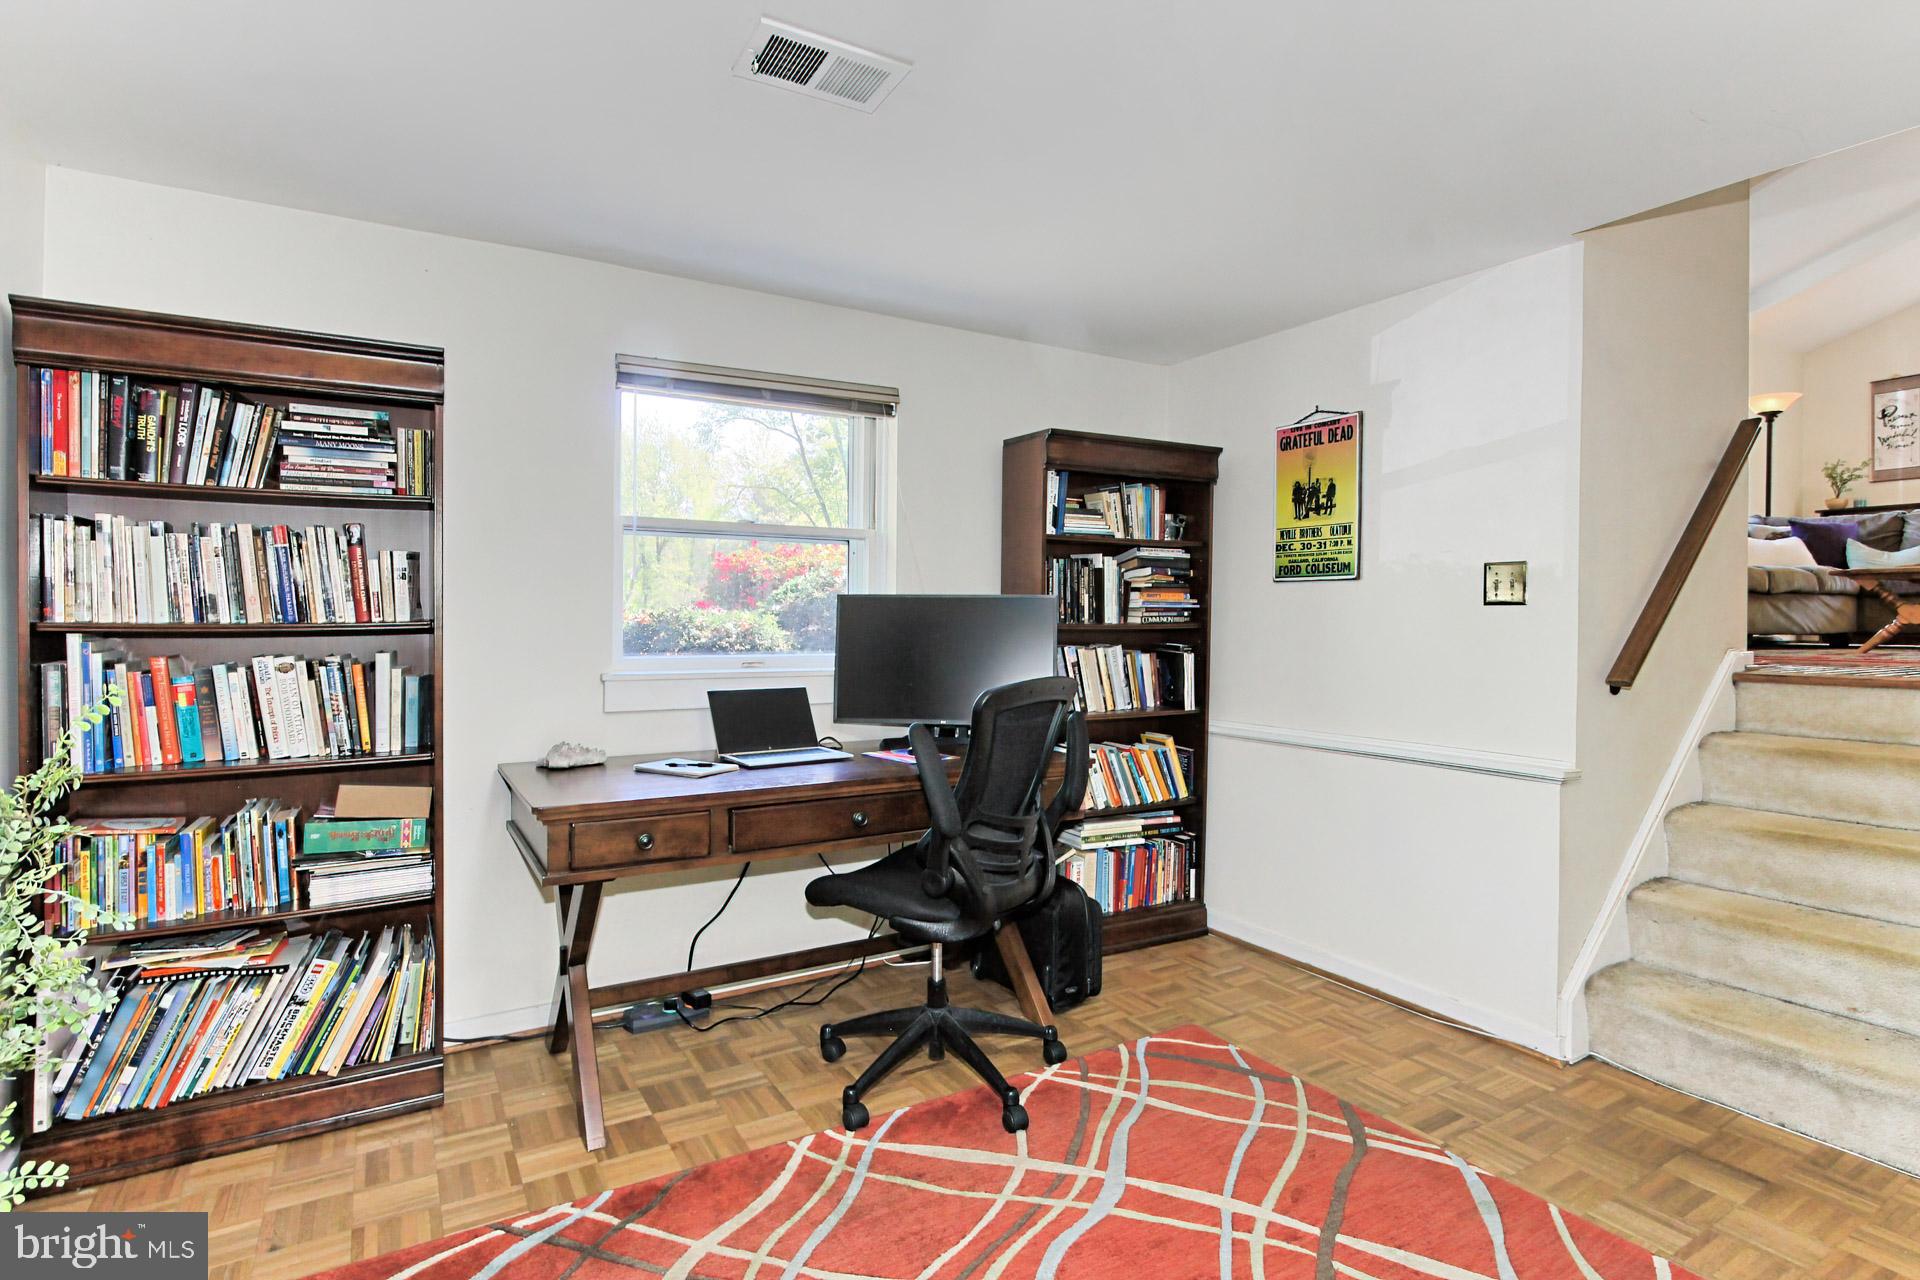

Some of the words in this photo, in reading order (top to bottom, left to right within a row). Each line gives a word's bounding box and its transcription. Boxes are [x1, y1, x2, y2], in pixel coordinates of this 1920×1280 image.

[137, 414, 147, 440] TRUTH
[147, 415, 157, 453] GANDHI'S
[176, 421, 189, 448] LOGIC
[1280, 431, 1324, 451] GRATEFUL
[1328, 424, 1354, 443] DEAD
[315, 440, 338, 448] MANY
[1300, 527, 1322, 538] BROTHERS
[1276, 544, 1296, 552] DEC.
[1300, 541, 1326, 550] 30-31
[1278, 565, 1302, 576] FORD
[1306, 562, 1350, 574] COLISEUM
[1142, 616, 1174, 624] COMMUNION
[279, 678, 289, 695] BOB
[266, 697, 276, 719] Triumph
[282, 697, 296, 745] WOODWARD
[294, 712, 305, 744] ATTACK
[264, 1008, 300, 1068] BRICKMASTER
